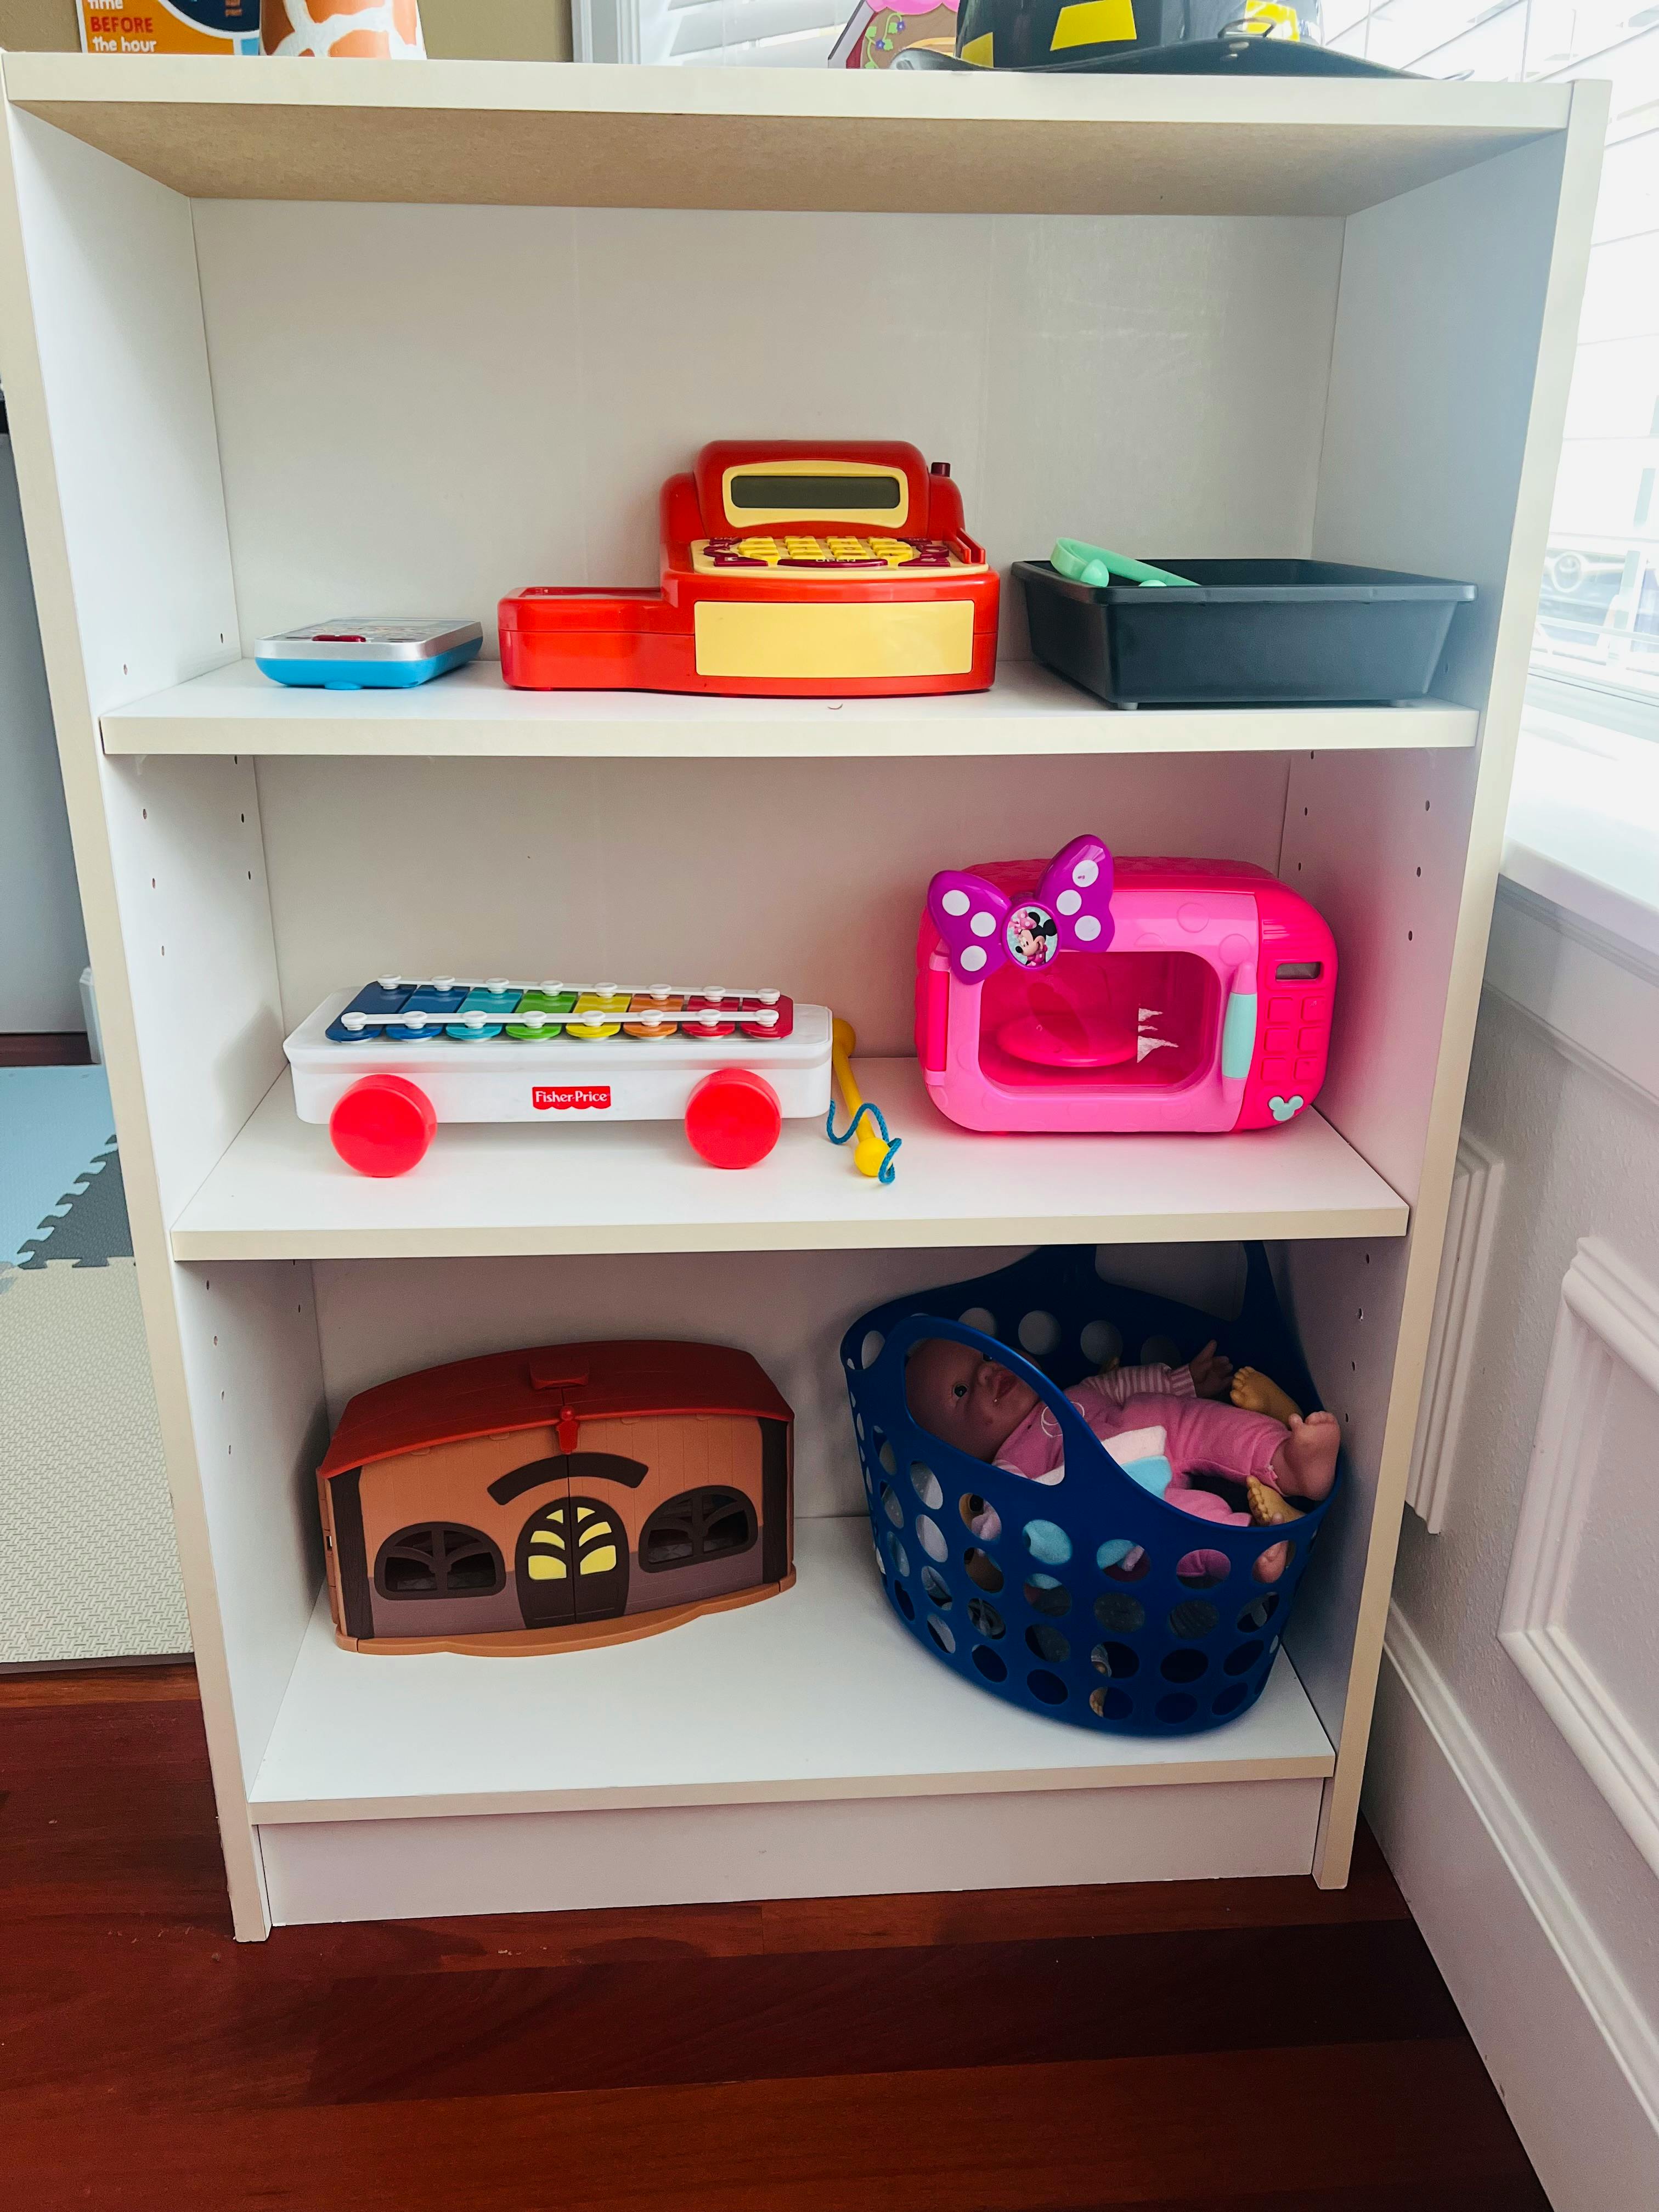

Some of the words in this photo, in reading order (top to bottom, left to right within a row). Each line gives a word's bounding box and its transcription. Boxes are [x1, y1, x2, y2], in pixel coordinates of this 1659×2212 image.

[91, 16, 153, 32] BEFORE
[92, 36, 117, 52] the
[121, 36, 157, 52] hour
[535, 1090, 607, 1103] Fisher-Price
